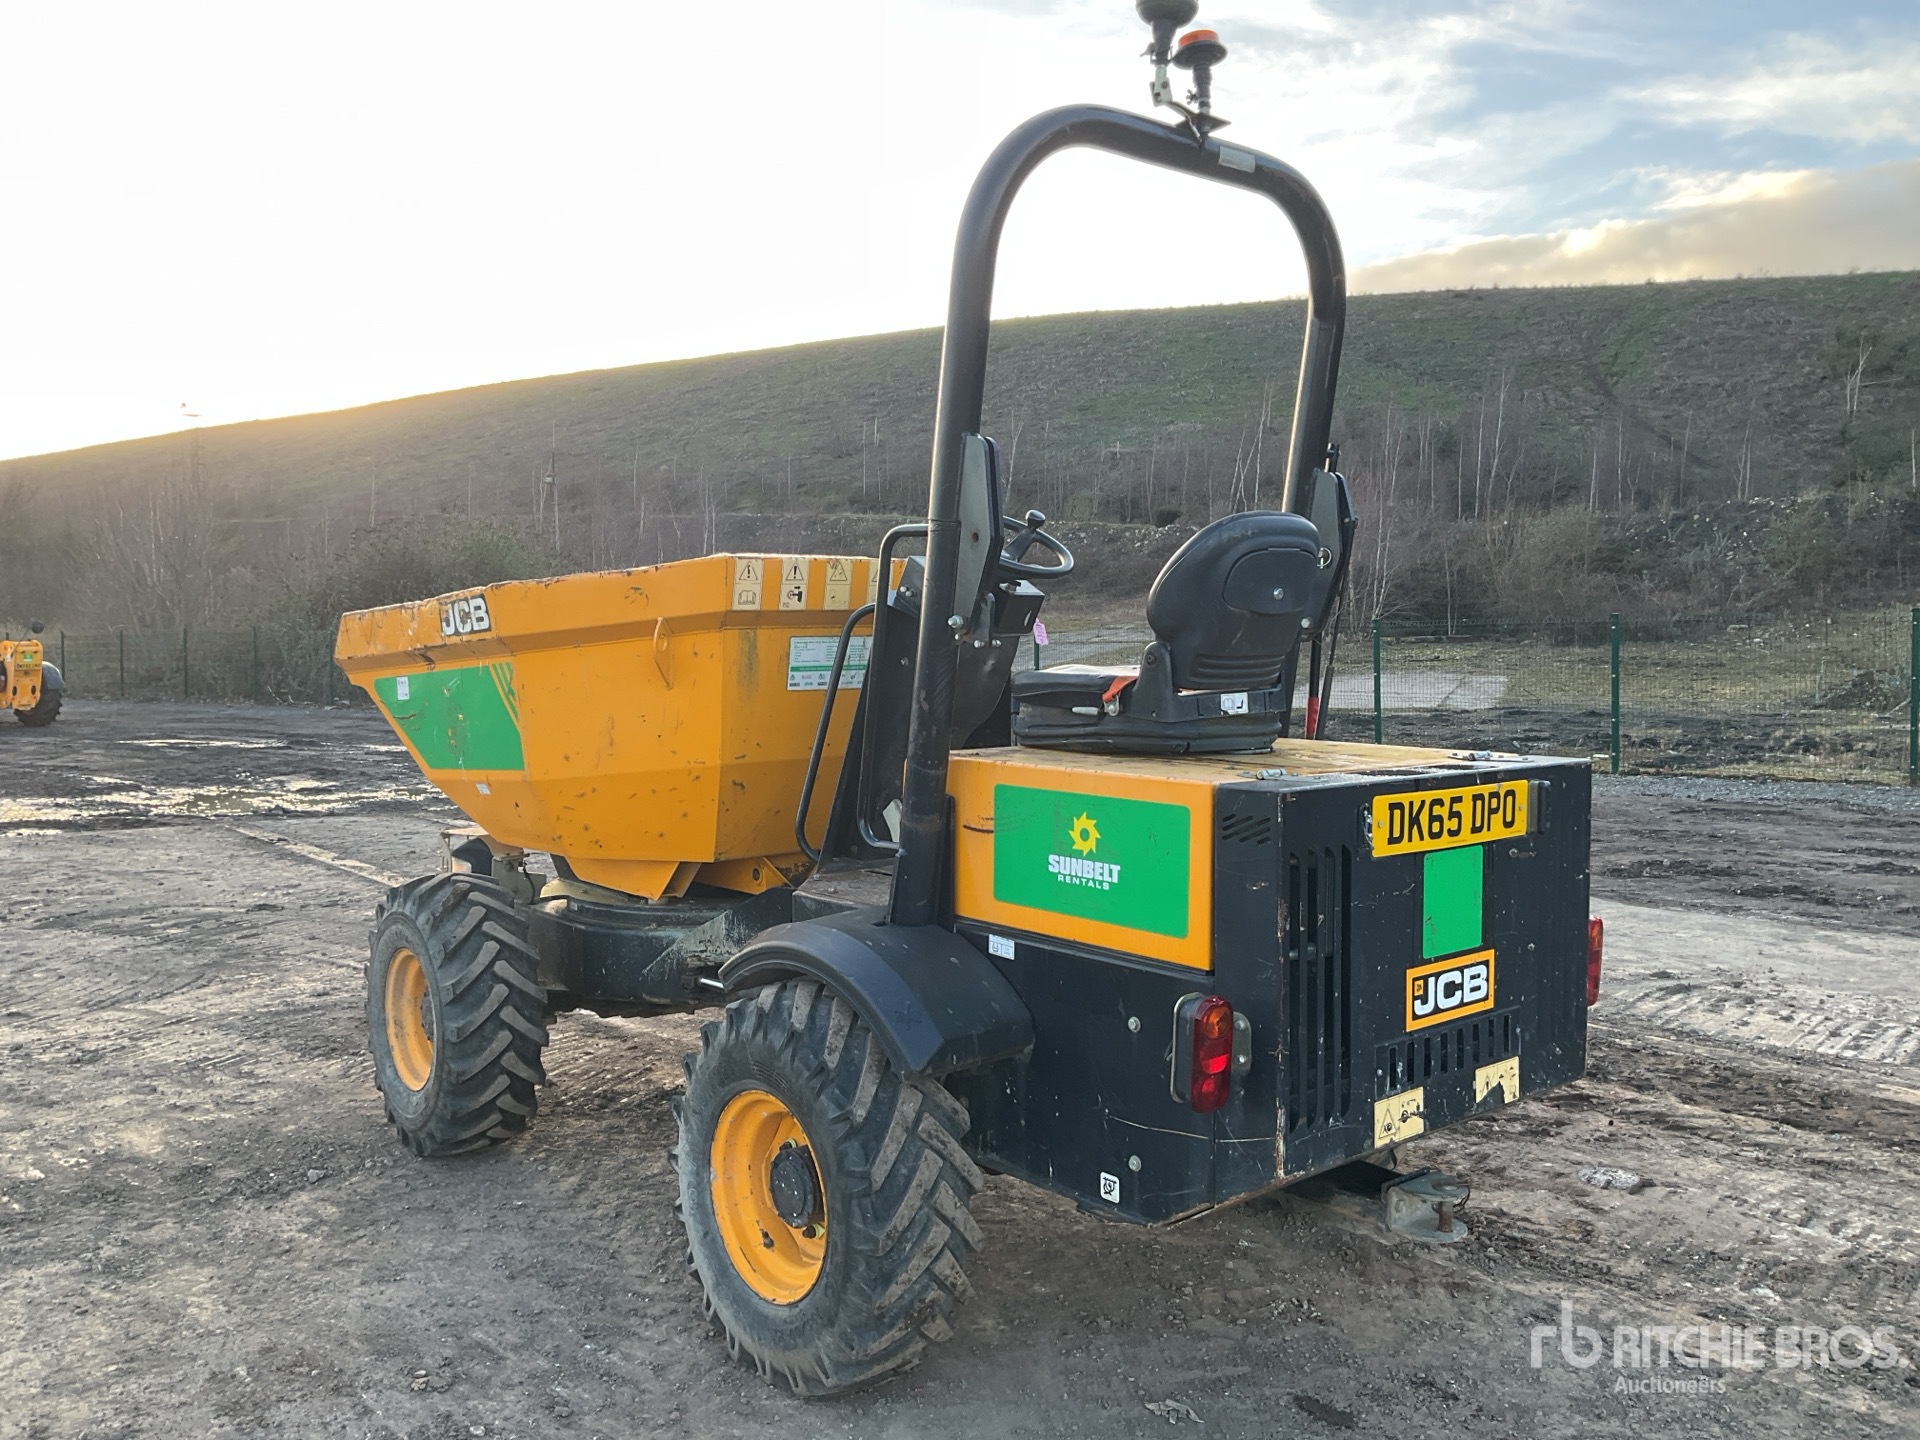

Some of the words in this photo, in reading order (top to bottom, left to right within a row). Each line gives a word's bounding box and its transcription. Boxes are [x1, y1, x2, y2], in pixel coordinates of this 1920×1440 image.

[441, 597, 490, 635] JCB
[1387, 796, 1463, 845] DK65
[1470, 789, 1516, 834] DPO
[1048, 854, 1121, 884] SUNBELT
[1057, 874, 1110, 891] RENTALS
[1413, 964, 1488, 1016] JCB
